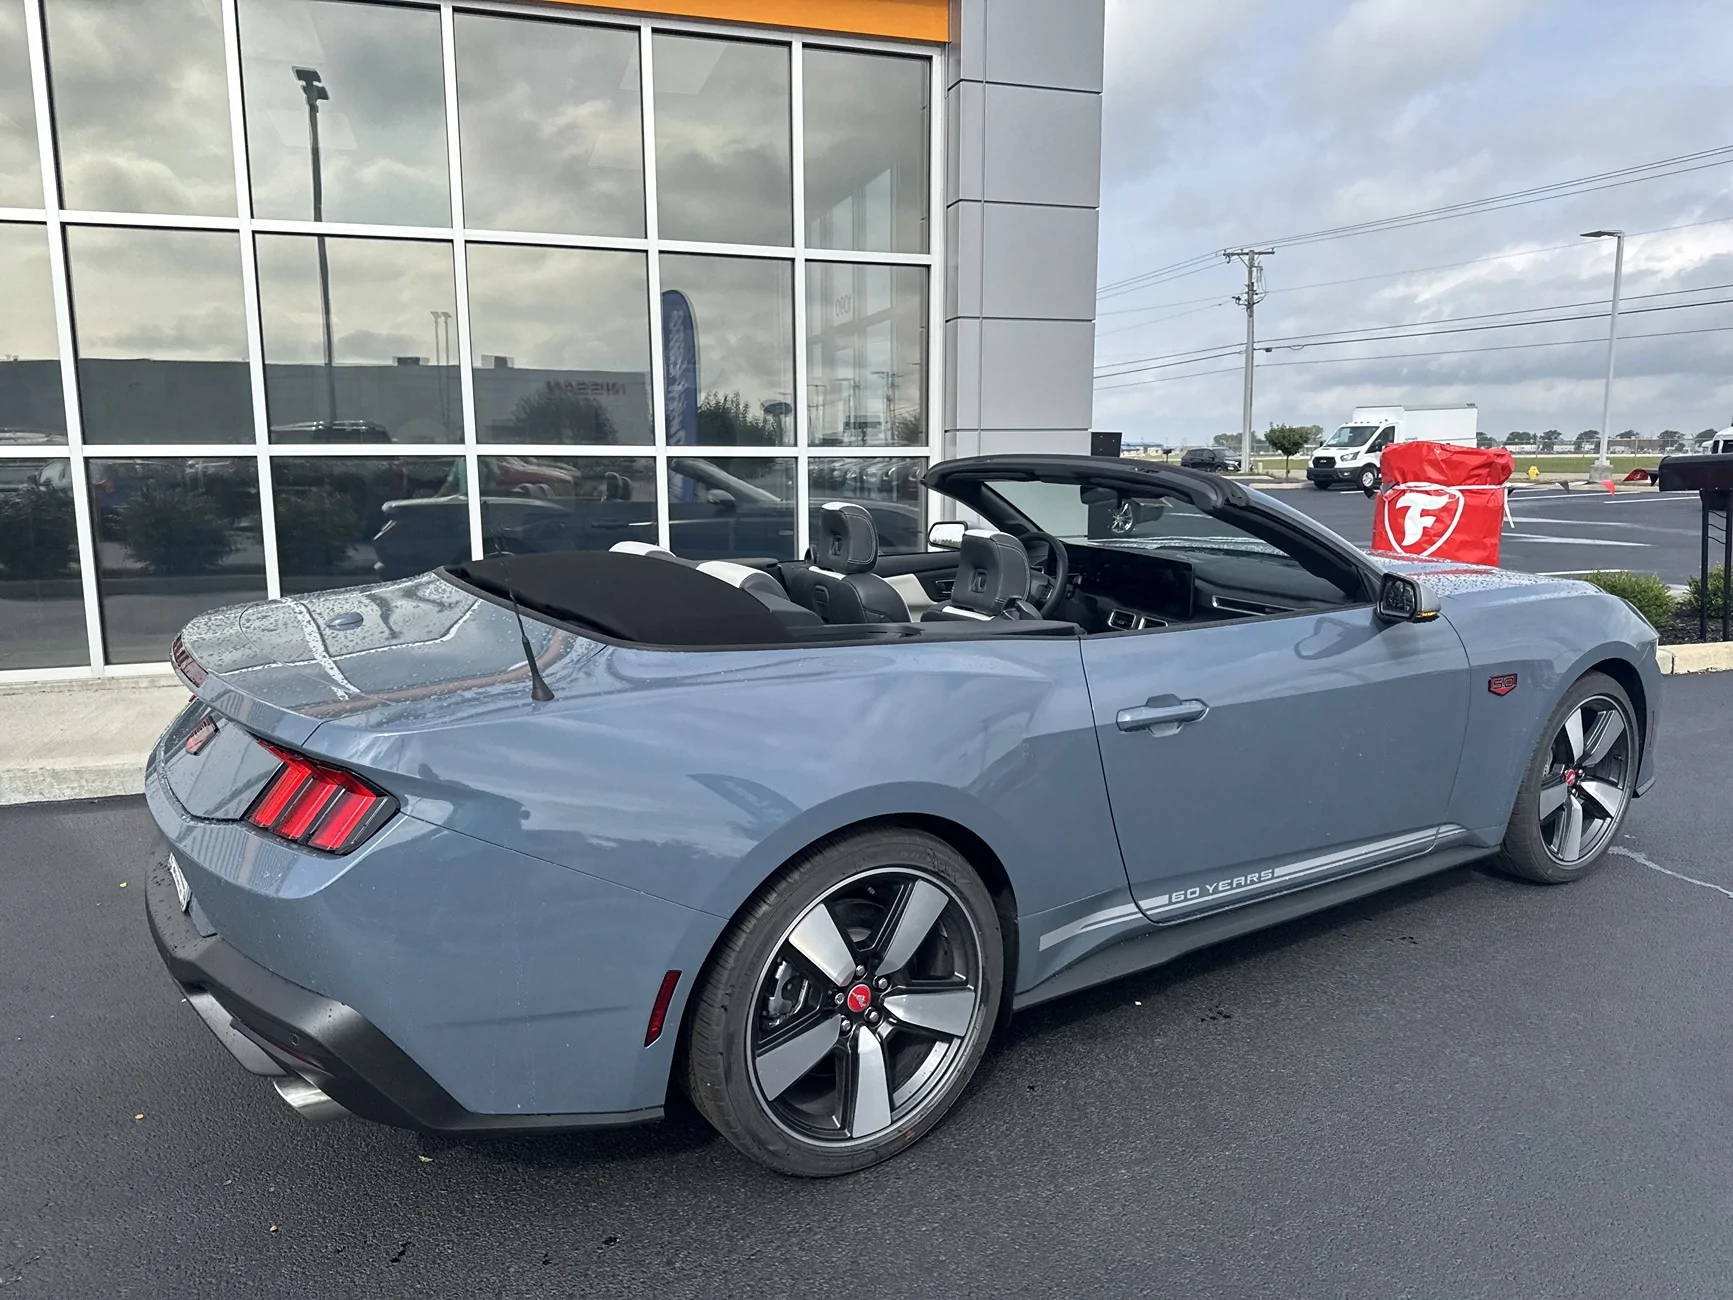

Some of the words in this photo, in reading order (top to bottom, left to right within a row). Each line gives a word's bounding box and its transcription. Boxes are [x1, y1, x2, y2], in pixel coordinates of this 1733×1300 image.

[1395, 491, 1450, 547] F
[1493, 676, 1515, 690] 5.0
[1171, 887, 1200, 903] 60
[1205, 869, 1273, 894] YEARS
